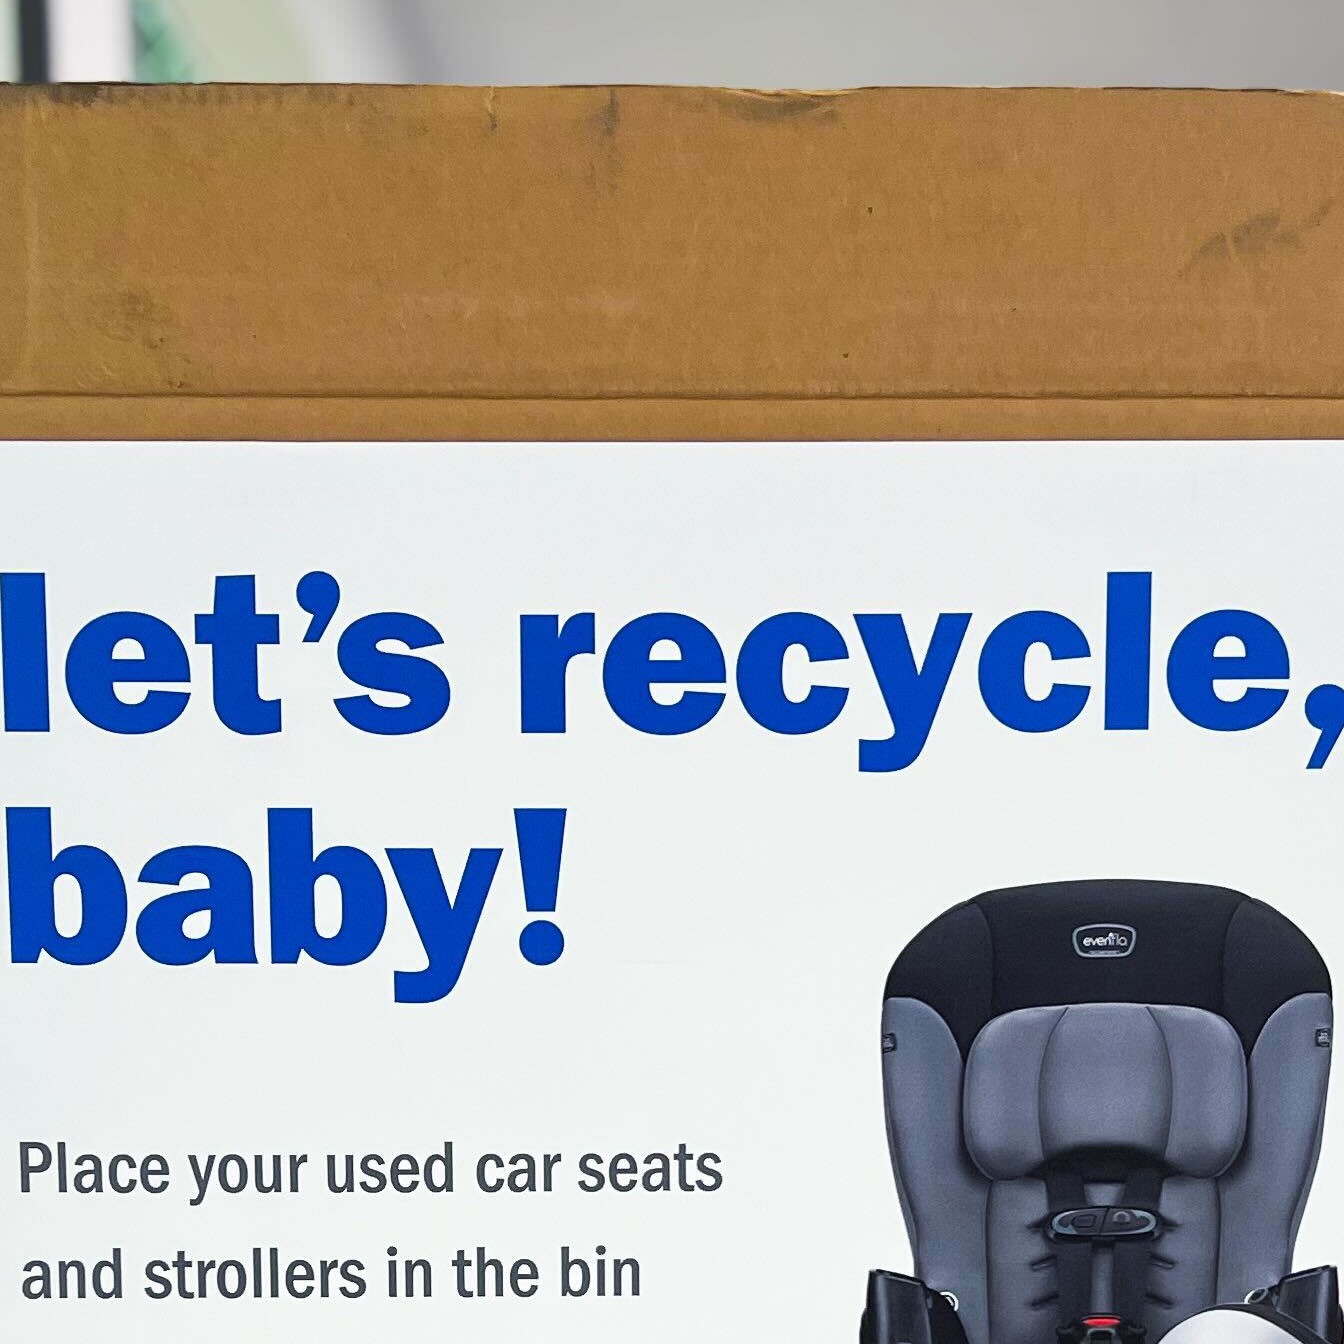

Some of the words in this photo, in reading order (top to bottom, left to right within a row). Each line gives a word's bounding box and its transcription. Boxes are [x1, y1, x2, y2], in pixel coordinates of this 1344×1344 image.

[0, 570, 451, 736] let's
[5, 806, 568, 1004] baby!
[19, 1141, 170, 1194] Place
[187, 1153, 308, 1207] your
[326, 1141, 454, 1194] used
[476, 1153, 562, 1193] car
[577, 1143, 723, 1193] seats
[21, 1247, 123, 1300] and
[143, 1247, 367, 1300] strollers
[386, 1245, 433, 1298] in
[451, 1246, 540, 1298] the
[560, 1244, 640, 1298] bin
